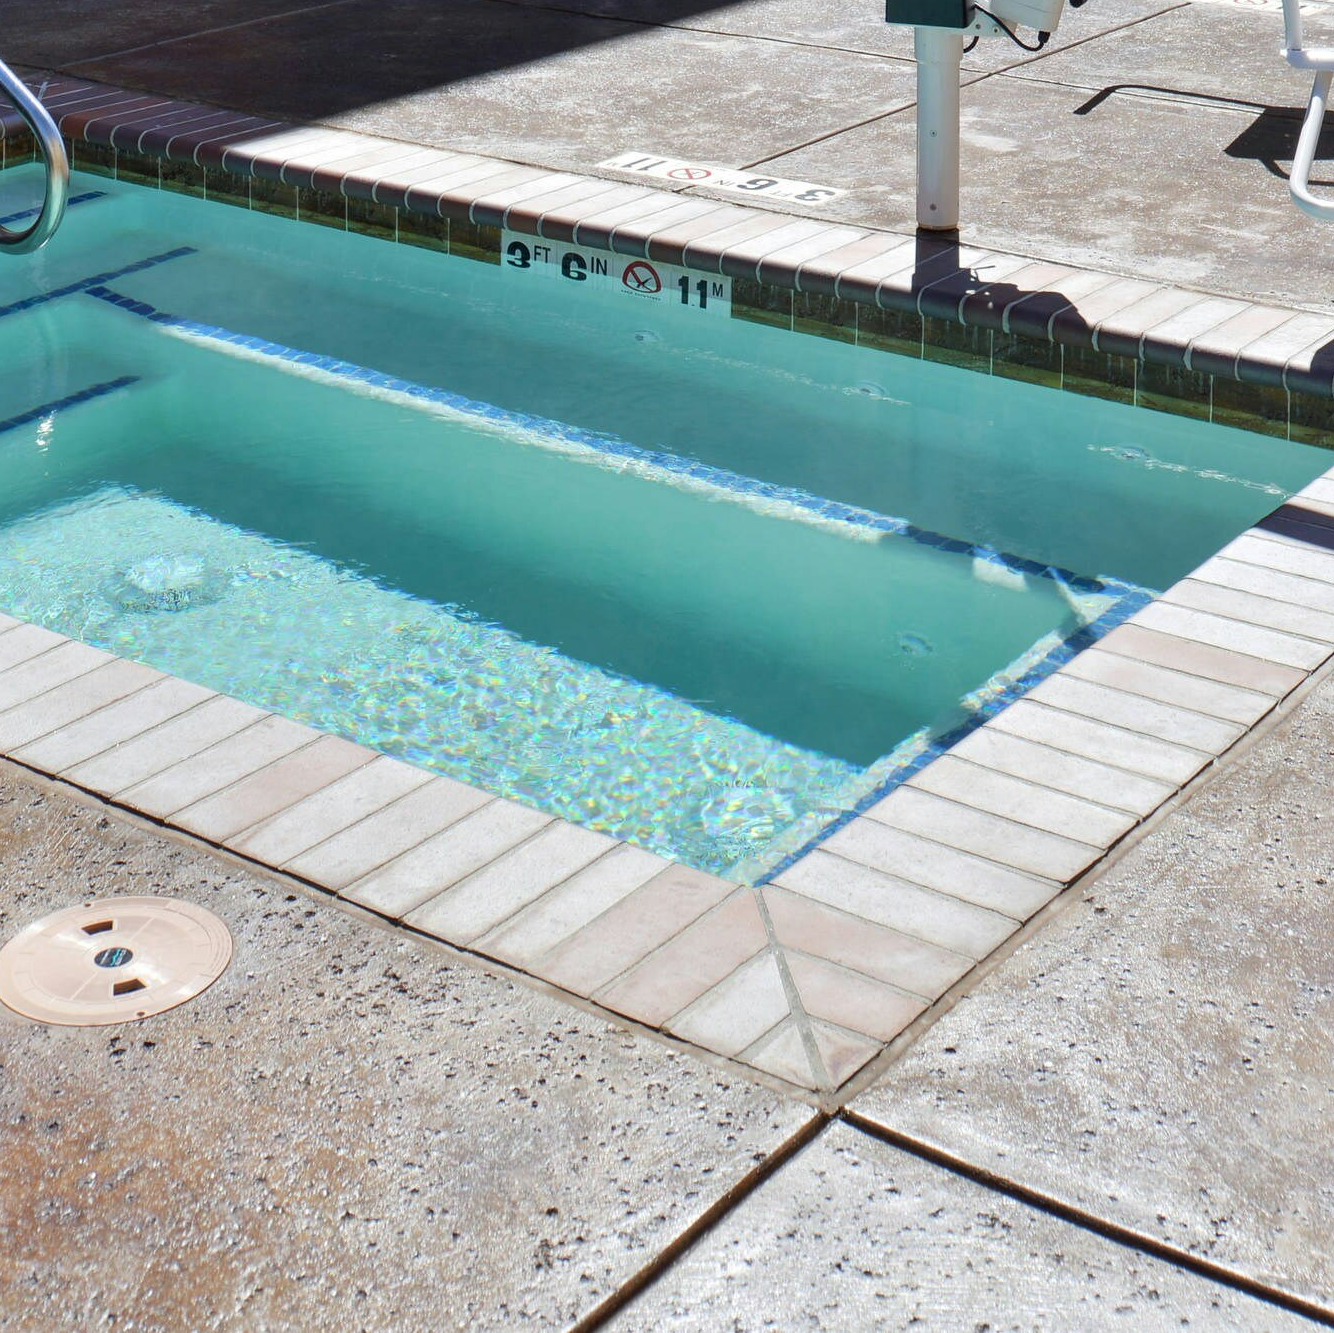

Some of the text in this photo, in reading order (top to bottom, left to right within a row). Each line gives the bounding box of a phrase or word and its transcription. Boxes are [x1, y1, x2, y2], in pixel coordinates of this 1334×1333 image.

[737, 178, 778, 190] 6
[795, 189, 835, 202] 3
[507, 241, 531, 268] 3
[533, 245, 551, 264] FT
[561, 252, 587, 281] 6
[591, 256, 607, 276] IN
[713, 282, 723, 298] M
